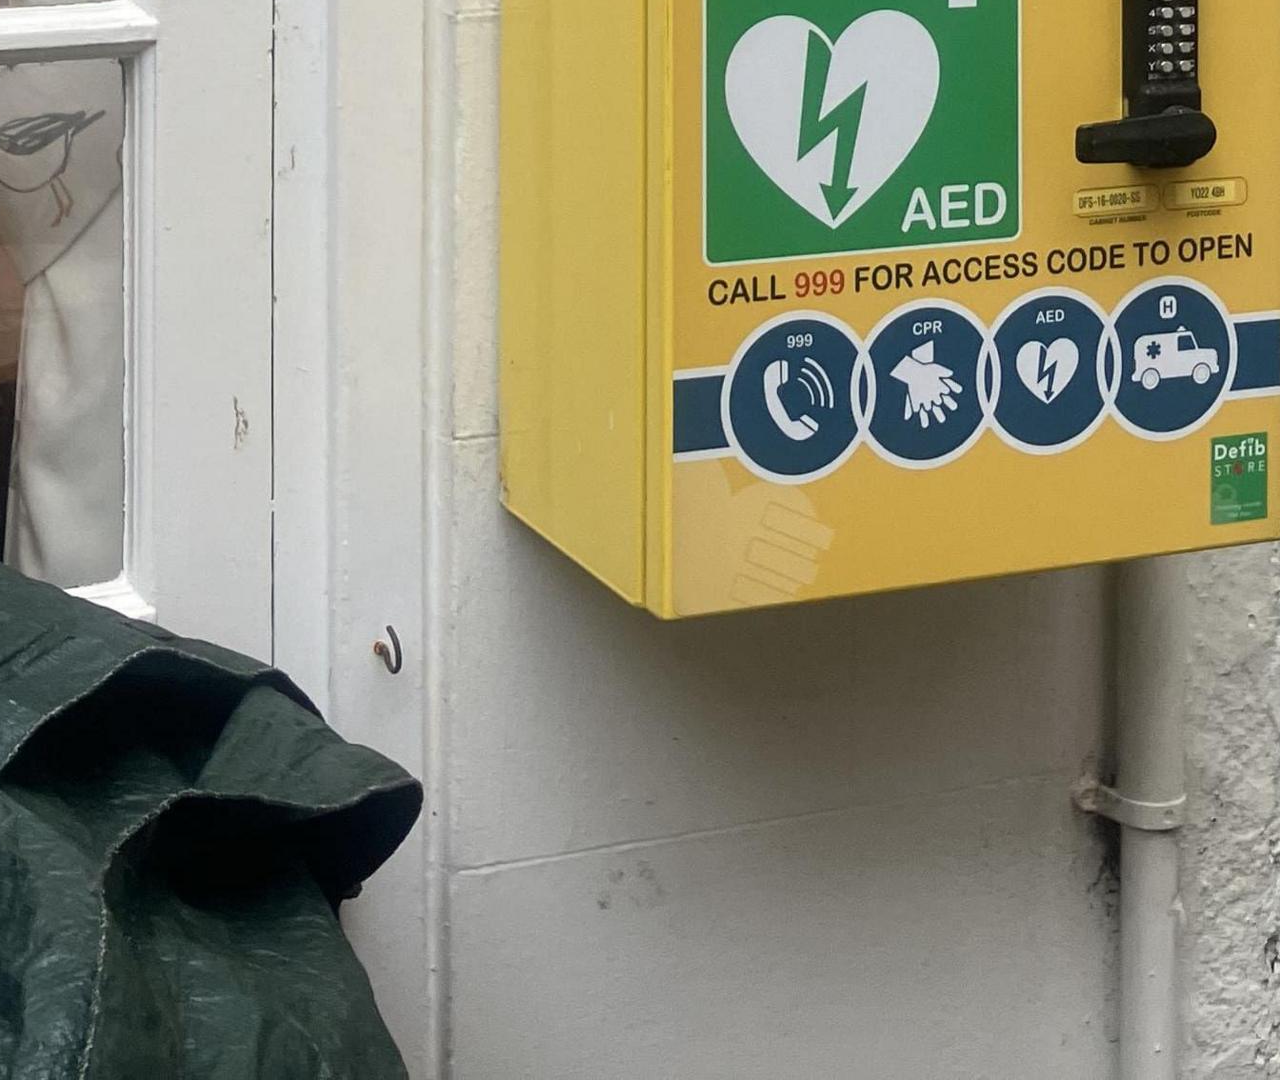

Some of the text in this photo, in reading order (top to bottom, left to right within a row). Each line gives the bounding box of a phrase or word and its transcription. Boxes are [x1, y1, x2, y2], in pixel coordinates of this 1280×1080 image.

[1148, 9, 1156, 17] 4
[1148, 62, 1156, 71] Y
[901, 182, 1007, 233] AED
[708, 232, 1253, 306] CALL 999 FOR ACCESS CODE TO OPEN
[1162, 298, 1174, 314] H
[1035, 308, 1066, 325] AED
[912, 320, 943, 336] CPR
[786, 333, 814, 348] 999
[1214, 437, 1266, 461] Defib
